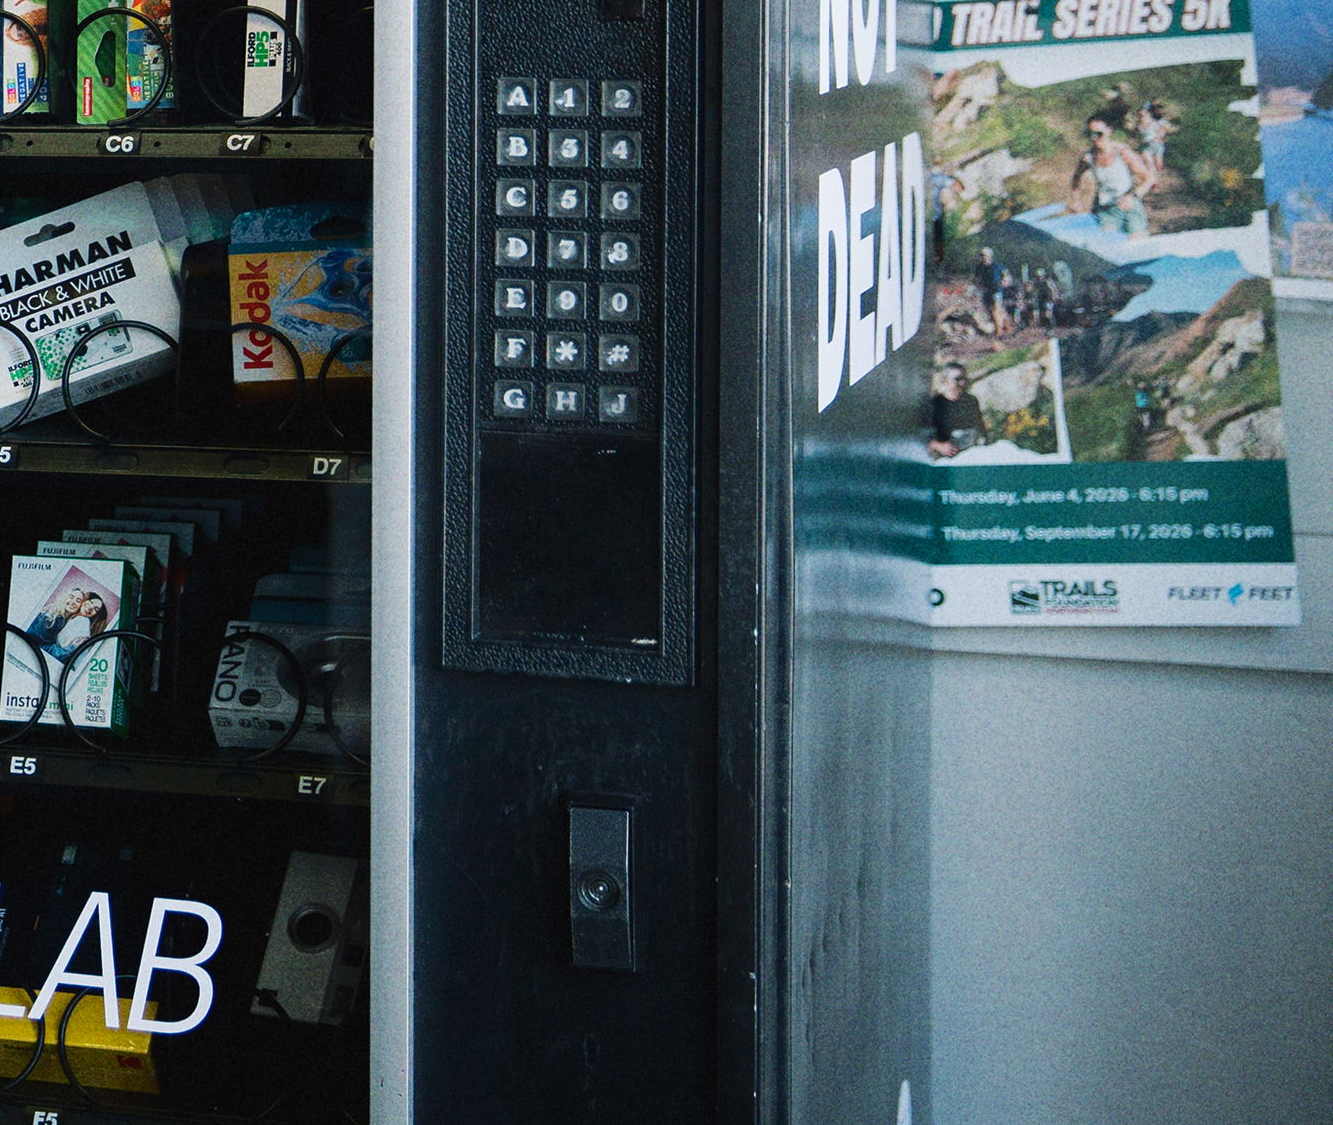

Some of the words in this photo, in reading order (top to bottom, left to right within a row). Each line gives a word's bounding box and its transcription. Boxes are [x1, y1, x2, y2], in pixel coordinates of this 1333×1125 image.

[247, 32, 256, 67] ILFORD
[254, 31, 269, 67] HP5
[507, 86, 529, 107] A
[564, 88, 575, 107] 1
[615, 89, 631, 109] 2
[105, 136, 134, 153] C6
[226, 135, 255, 151] C7
[508, 136, 528, 157] B
[561, 138, 578, 158] 3
[612, 140, 629, 159] 4
[506, 187, 526, 208] C
[561, 189, 577, 209] 5
[613, 191, 629, 211] 6
[508, 237, 528, 258] D
[559, 240, 576, 259] 7
[614, 242, 628, 261] 8
[55, 285, 71, 301] &
[70, 263, 127, 293] WHITE
[818, 131, 925, 414] DEAD
[507, 288, 526, 308] E
[560, 290, 576, 310] 9
[613, 292, 628, 312] 0
[24, 291, 116, 334] CAMERA
[238, 258, 274, 370] Kodak
[507, 338, 526, 359] F
[504, 389, 526, 409] G
[555, 391, 577, 411] H
[612, 394, 627, 414] J
[313, 458, 342, 475] D7
[938, 489, 1021, 507] Thursday,
[1022, 488, 1065, 504] June
[1066, 487, 1083, 504] 4,
[1084, 487, 1130, 503] 2026
[1179, 488, 1209, 504] pm
[941, 526, 1023, 543] Thursday,
[1024, 525, 1116, 543] September
[1119, 524, 1146, 541] 17,
[1148, 523, 1194, 539] 2026
[1244, 525, 1275, 541] pm
[43, 547, 76, 555] FUJIFILM
[18, 562, 52, 571] FUJIFILM
[1040, 581, 1118, 597] TRAILS
[1168, 586, 1225, 600] FLEET
[1249, 586, 1294, 600] FEET
[89, 658, 108, 672] 20
[10, 756, 36, 775] E5
[299, 777, 327, 794] E7
